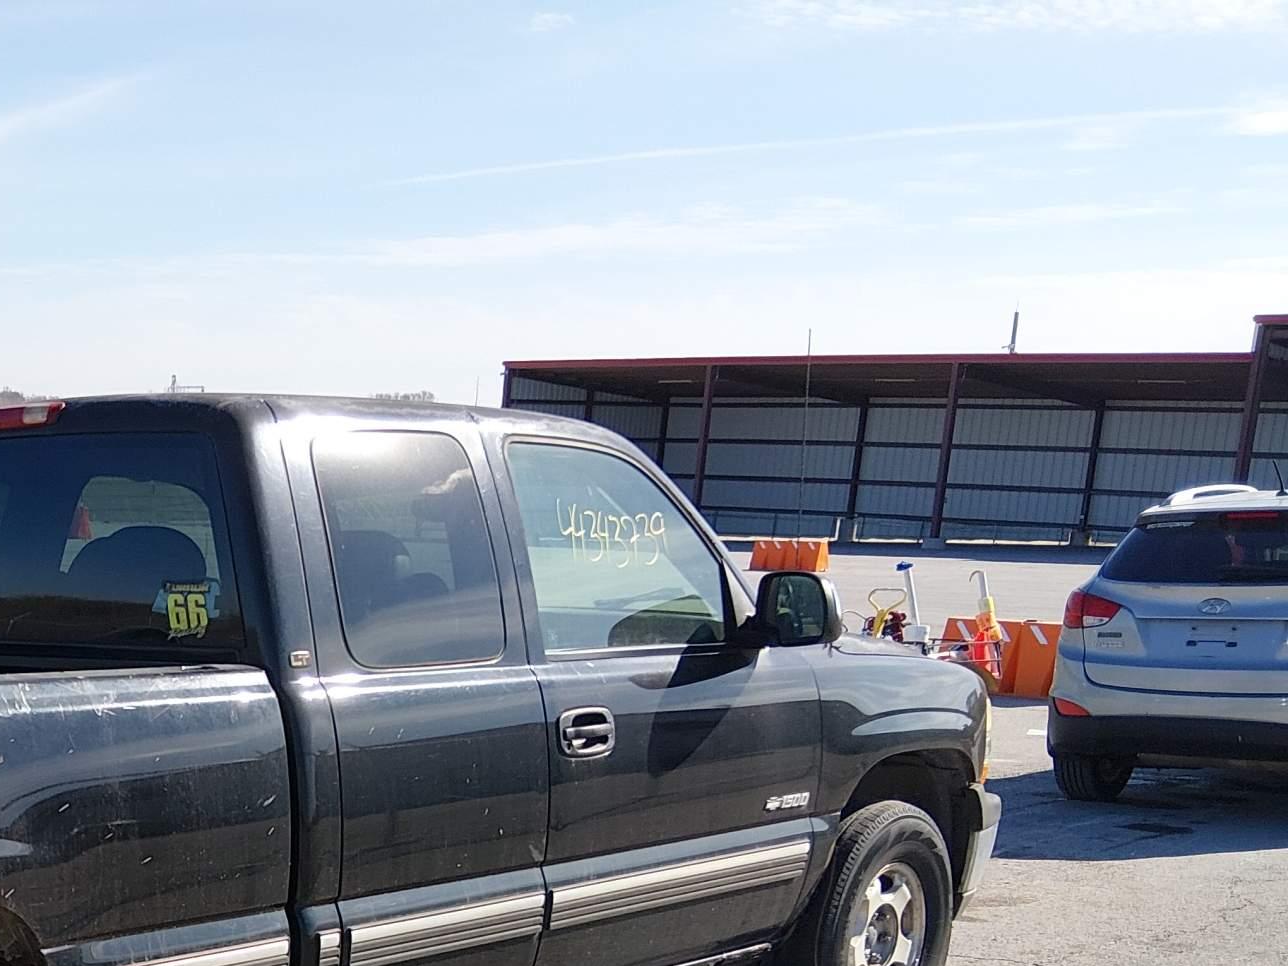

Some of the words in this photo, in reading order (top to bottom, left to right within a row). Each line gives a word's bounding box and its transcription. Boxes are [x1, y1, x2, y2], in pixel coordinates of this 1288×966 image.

[556, 498, 669, 569] 44343739
[168, 594, 208, 630] 66
[781, 792, 810, 809] 1500
